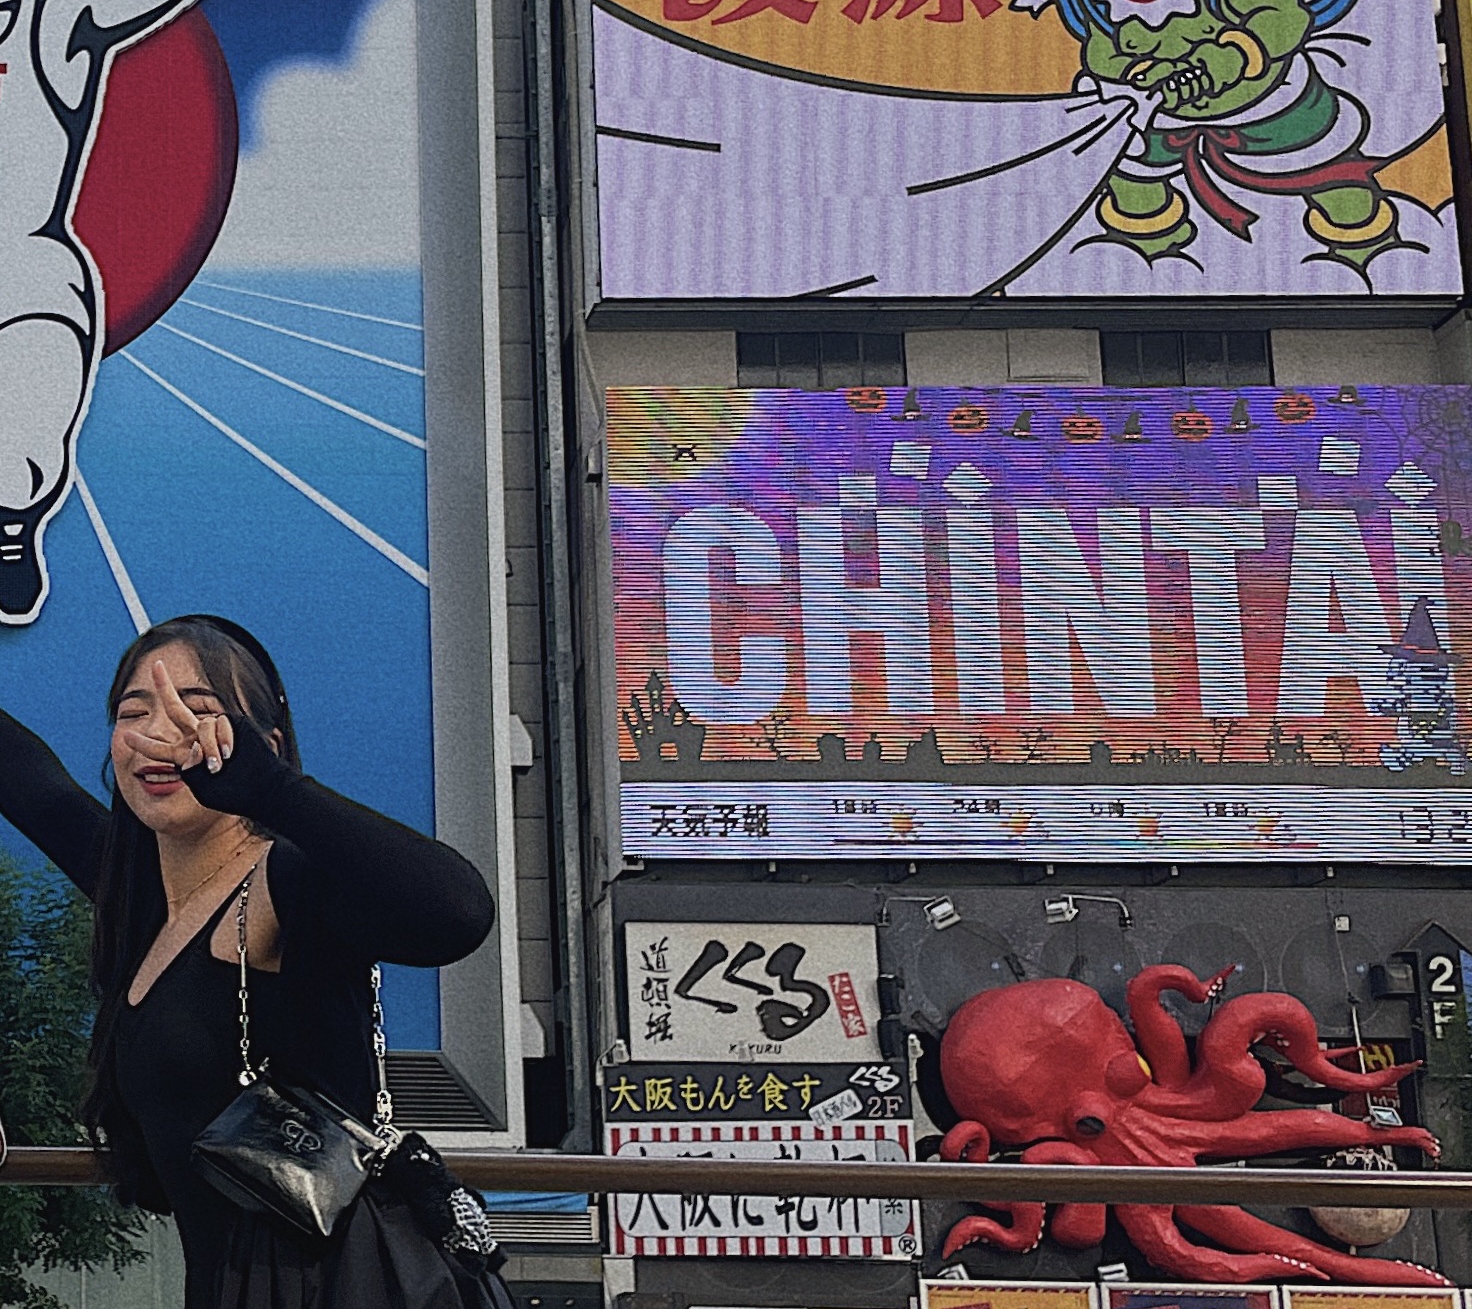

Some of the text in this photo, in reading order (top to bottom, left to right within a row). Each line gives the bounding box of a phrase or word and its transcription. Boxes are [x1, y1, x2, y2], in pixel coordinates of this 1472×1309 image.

[674, 939, 830, 1041] くくる
[610, 1072, 821, 1112] 大阪もんを食す
[849, 1066, 901, 1092] くくる
[868, 1095, 904, 1118] 2F
